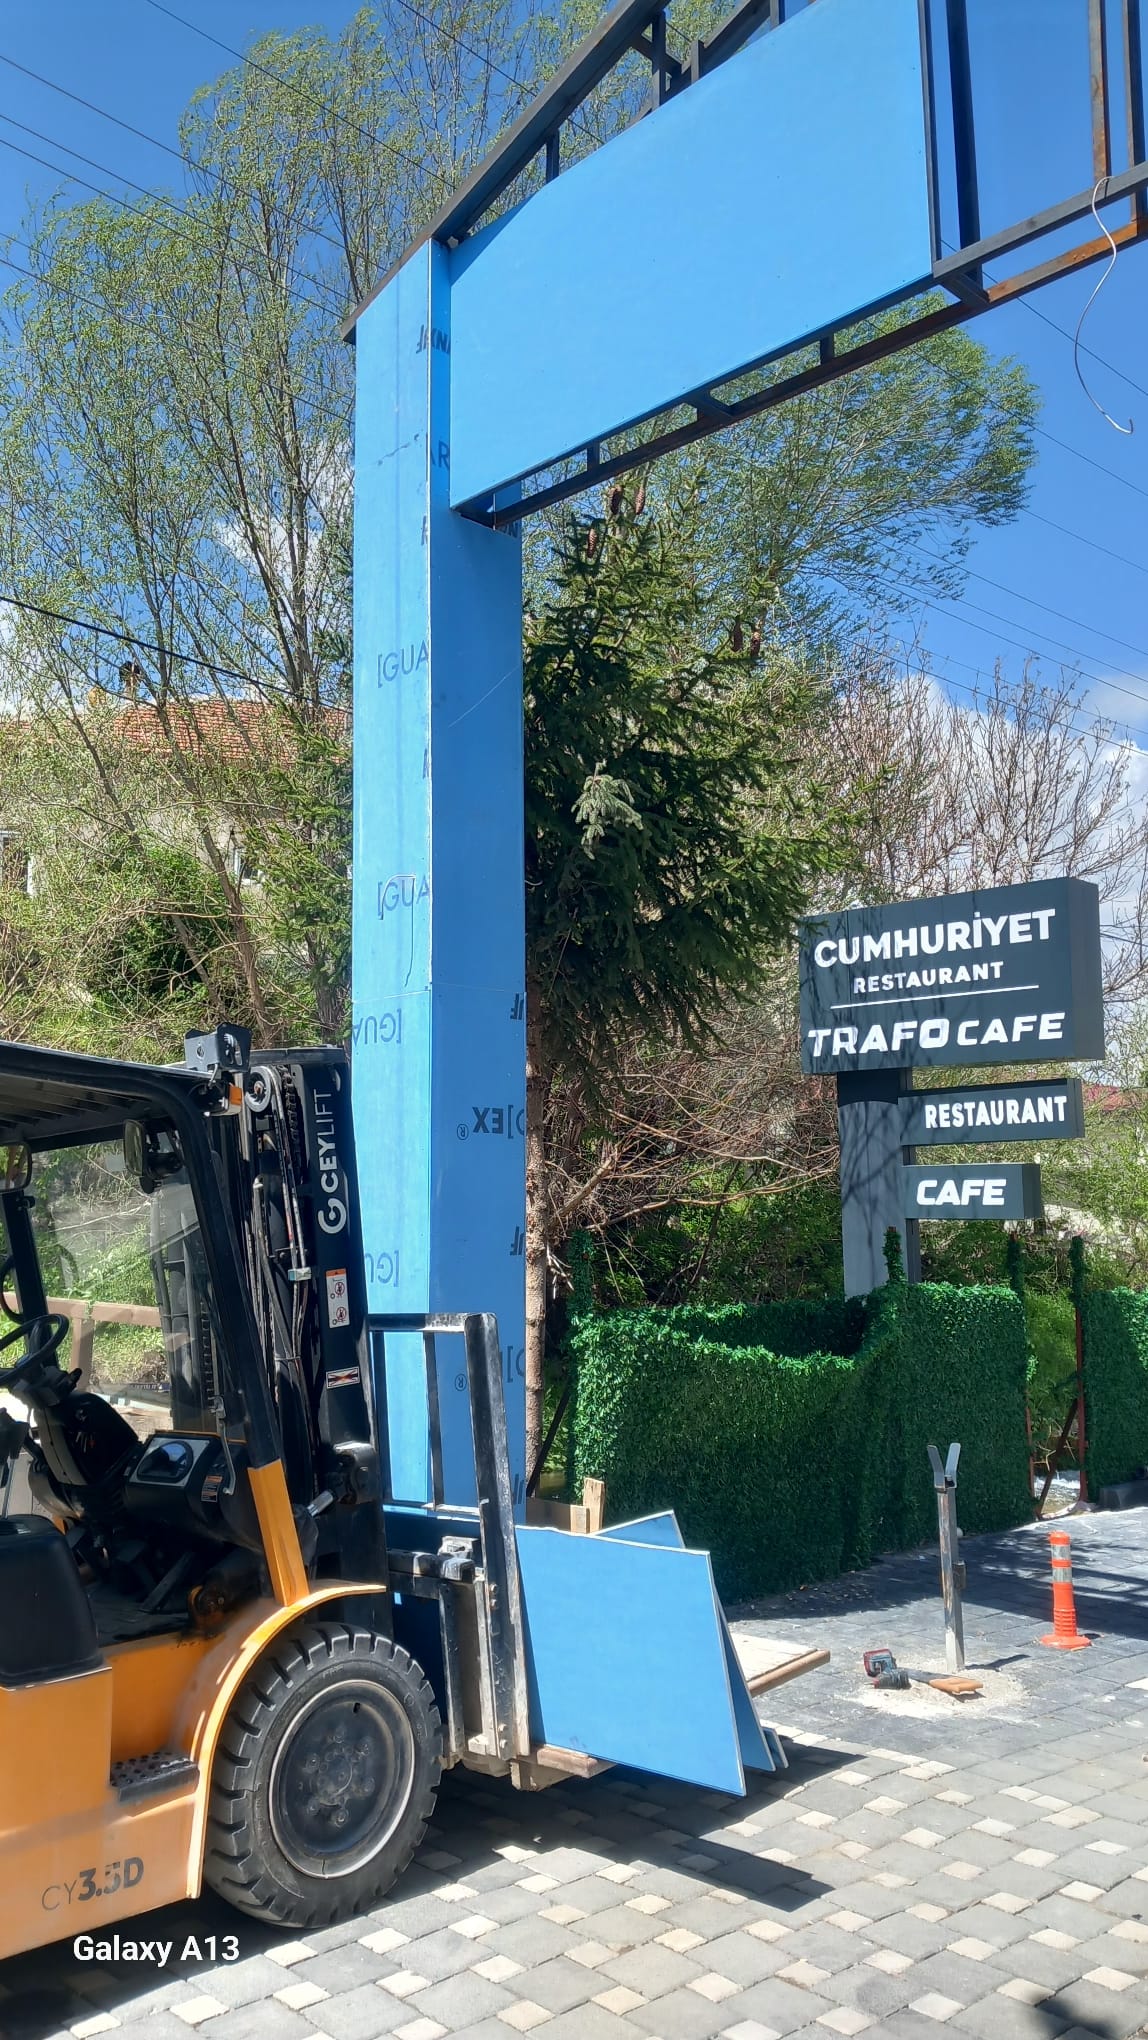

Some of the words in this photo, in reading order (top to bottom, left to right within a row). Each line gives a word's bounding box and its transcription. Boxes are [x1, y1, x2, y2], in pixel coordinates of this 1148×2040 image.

[814, 908, 1056, 968] CUMHURİYET
[853, 961, 1004, 993] RESTAURANT
[807, 1017, 949, 1057] TRAFO
[957, 1012, 1065, 1046] CAFE
[925, 1095, 1067, 1129] RESTAURANT
[313, 1088, 339, 1193] CEYLIFT
[916, 1178, 1007, 1206] CAFE
